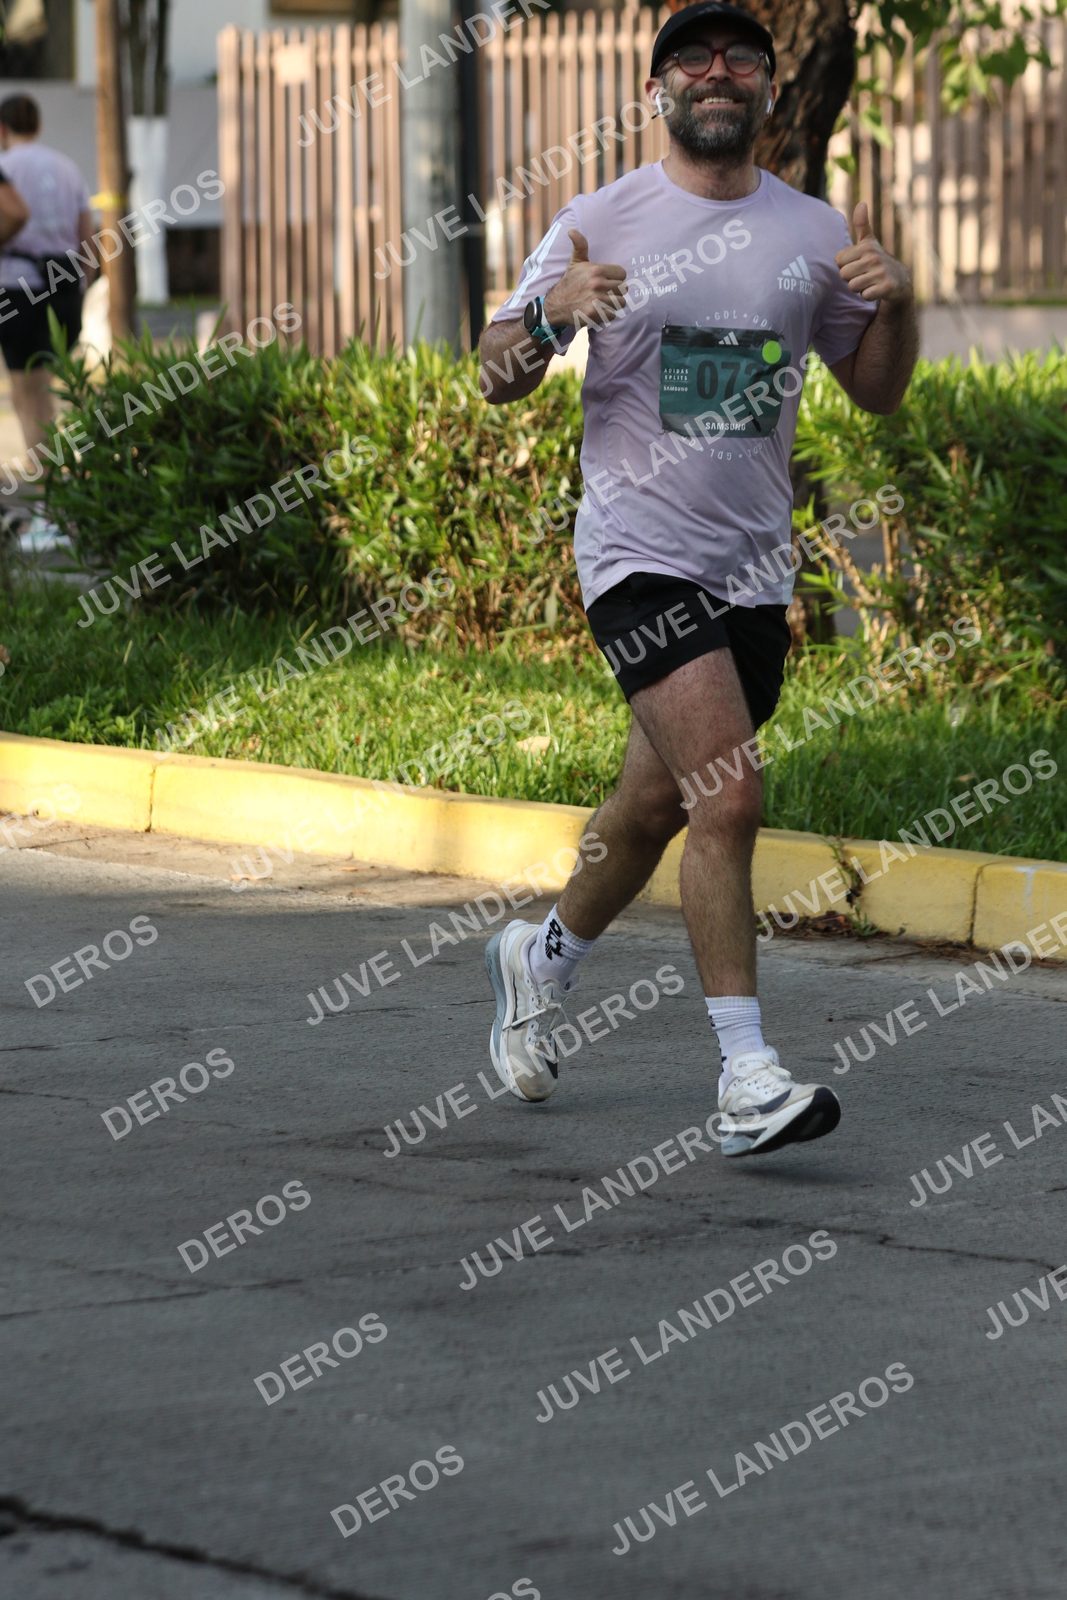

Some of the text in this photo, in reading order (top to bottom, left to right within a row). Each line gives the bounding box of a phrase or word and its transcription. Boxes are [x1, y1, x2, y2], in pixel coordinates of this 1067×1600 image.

[777, 277, 797, 292] TOP
[714, 309, 737, 321] GDL
[697, 360, 760, 401] 07
[705, 421, 746, 431] SAMSUNG
